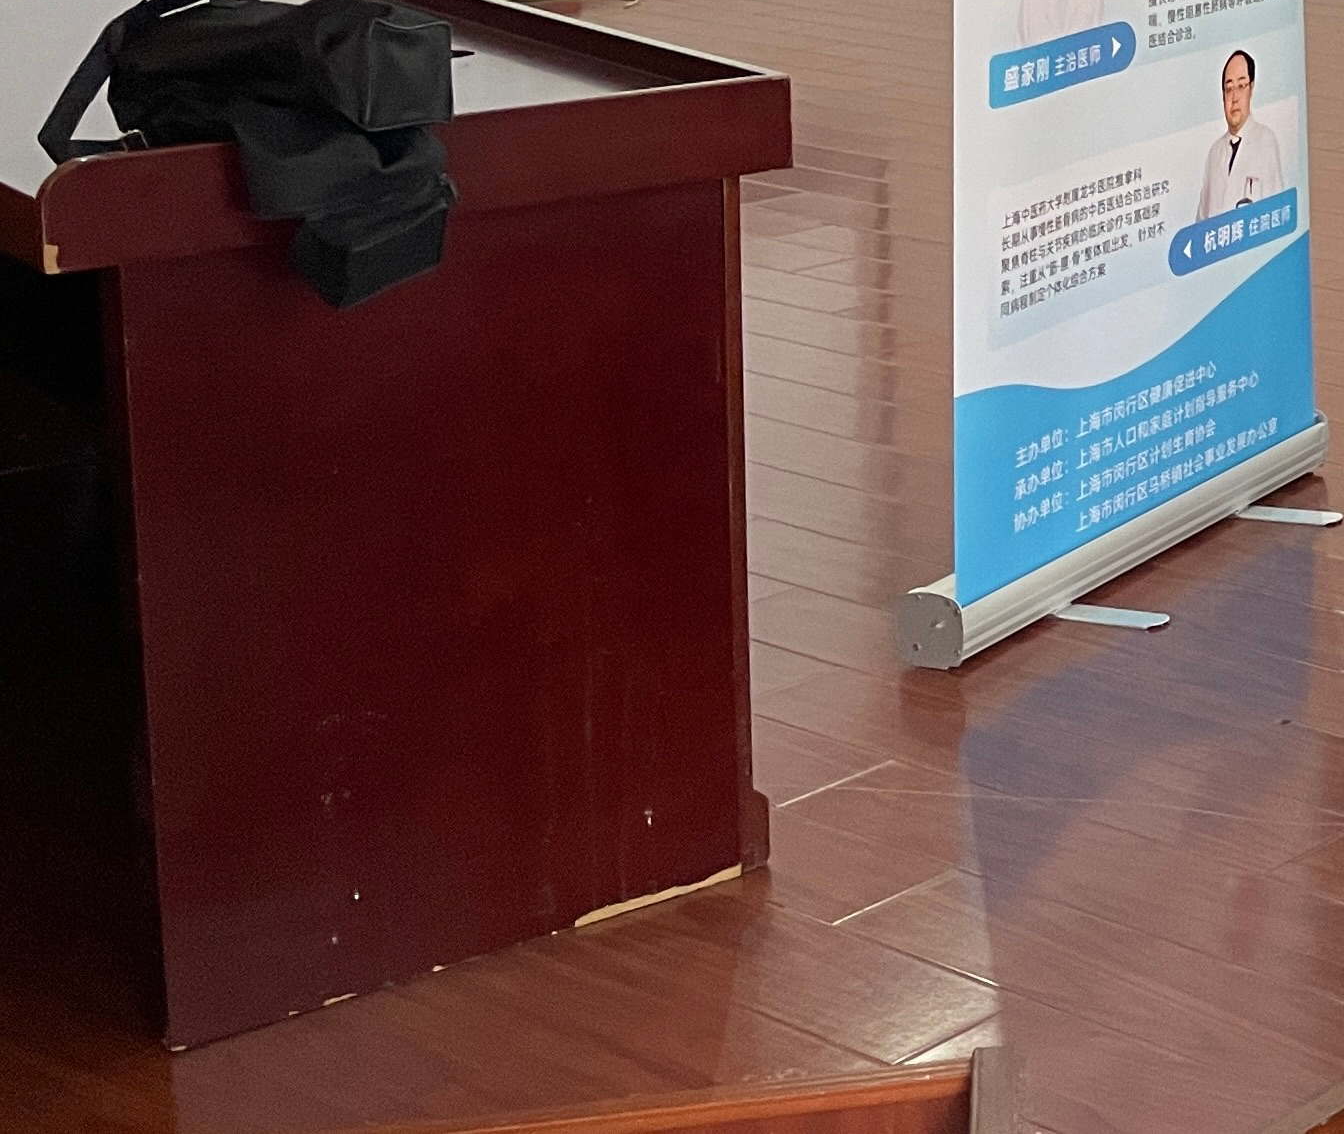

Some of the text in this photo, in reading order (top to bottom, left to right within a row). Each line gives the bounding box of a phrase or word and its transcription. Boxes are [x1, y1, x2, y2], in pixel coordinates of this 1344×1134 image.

[1054, 45, 1101, 77] 主治医师
[1249, 205, 1291, 237] 住院医师
[1076, 360, 1217, 438] 上海市闵行区健康促进中心
[1076, 369, 1259, 469] 上海市人口和家庭计划指导服务中心
[1076, 418, 1216, 502] 上海市闵行区计划生育协会
